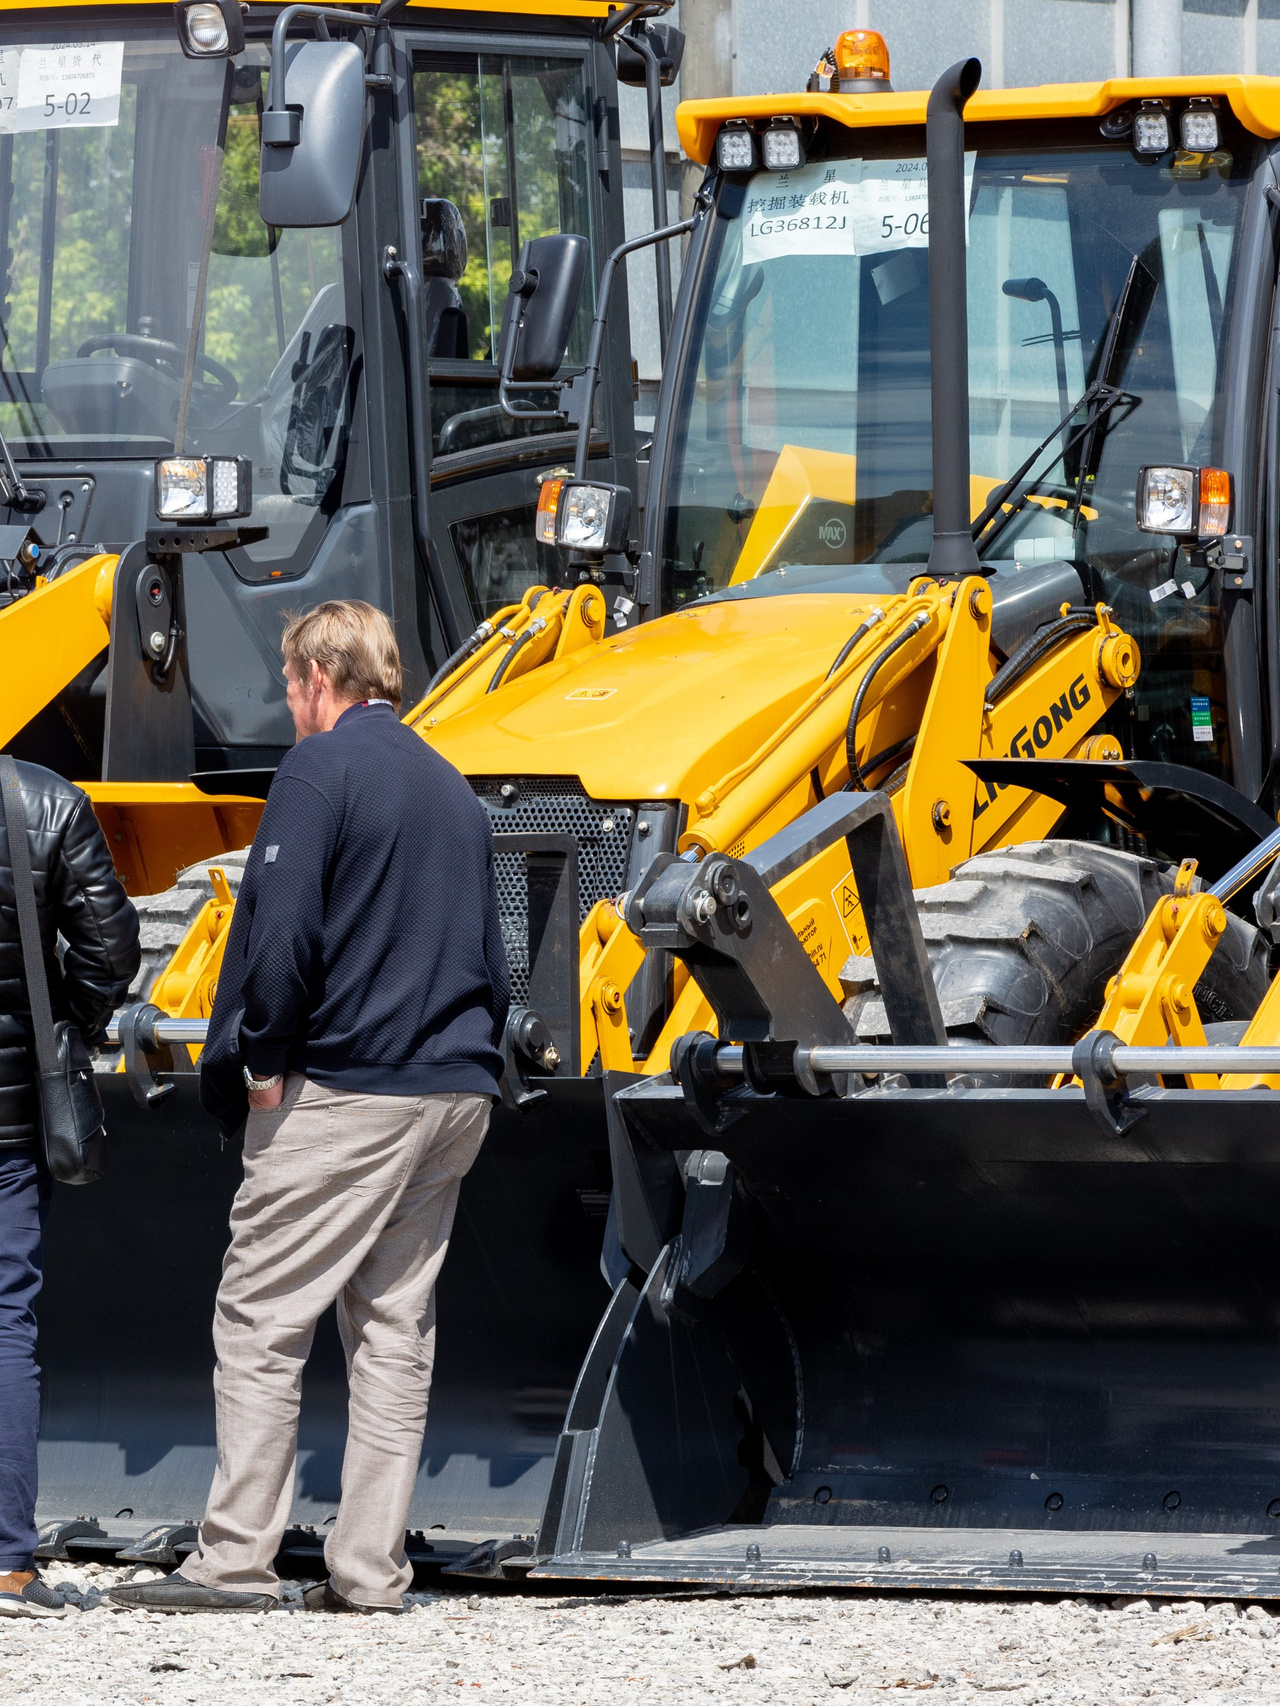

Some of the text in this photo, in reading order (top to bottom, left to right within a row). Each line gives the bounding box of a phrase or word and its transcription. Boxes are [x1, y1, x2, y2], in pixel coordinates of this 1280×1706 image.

[44, 92, 91, 117] 5-02
[747, 190, 849, 213] 挖掘装载机
[750, 216, 847, 237] LG36812J
